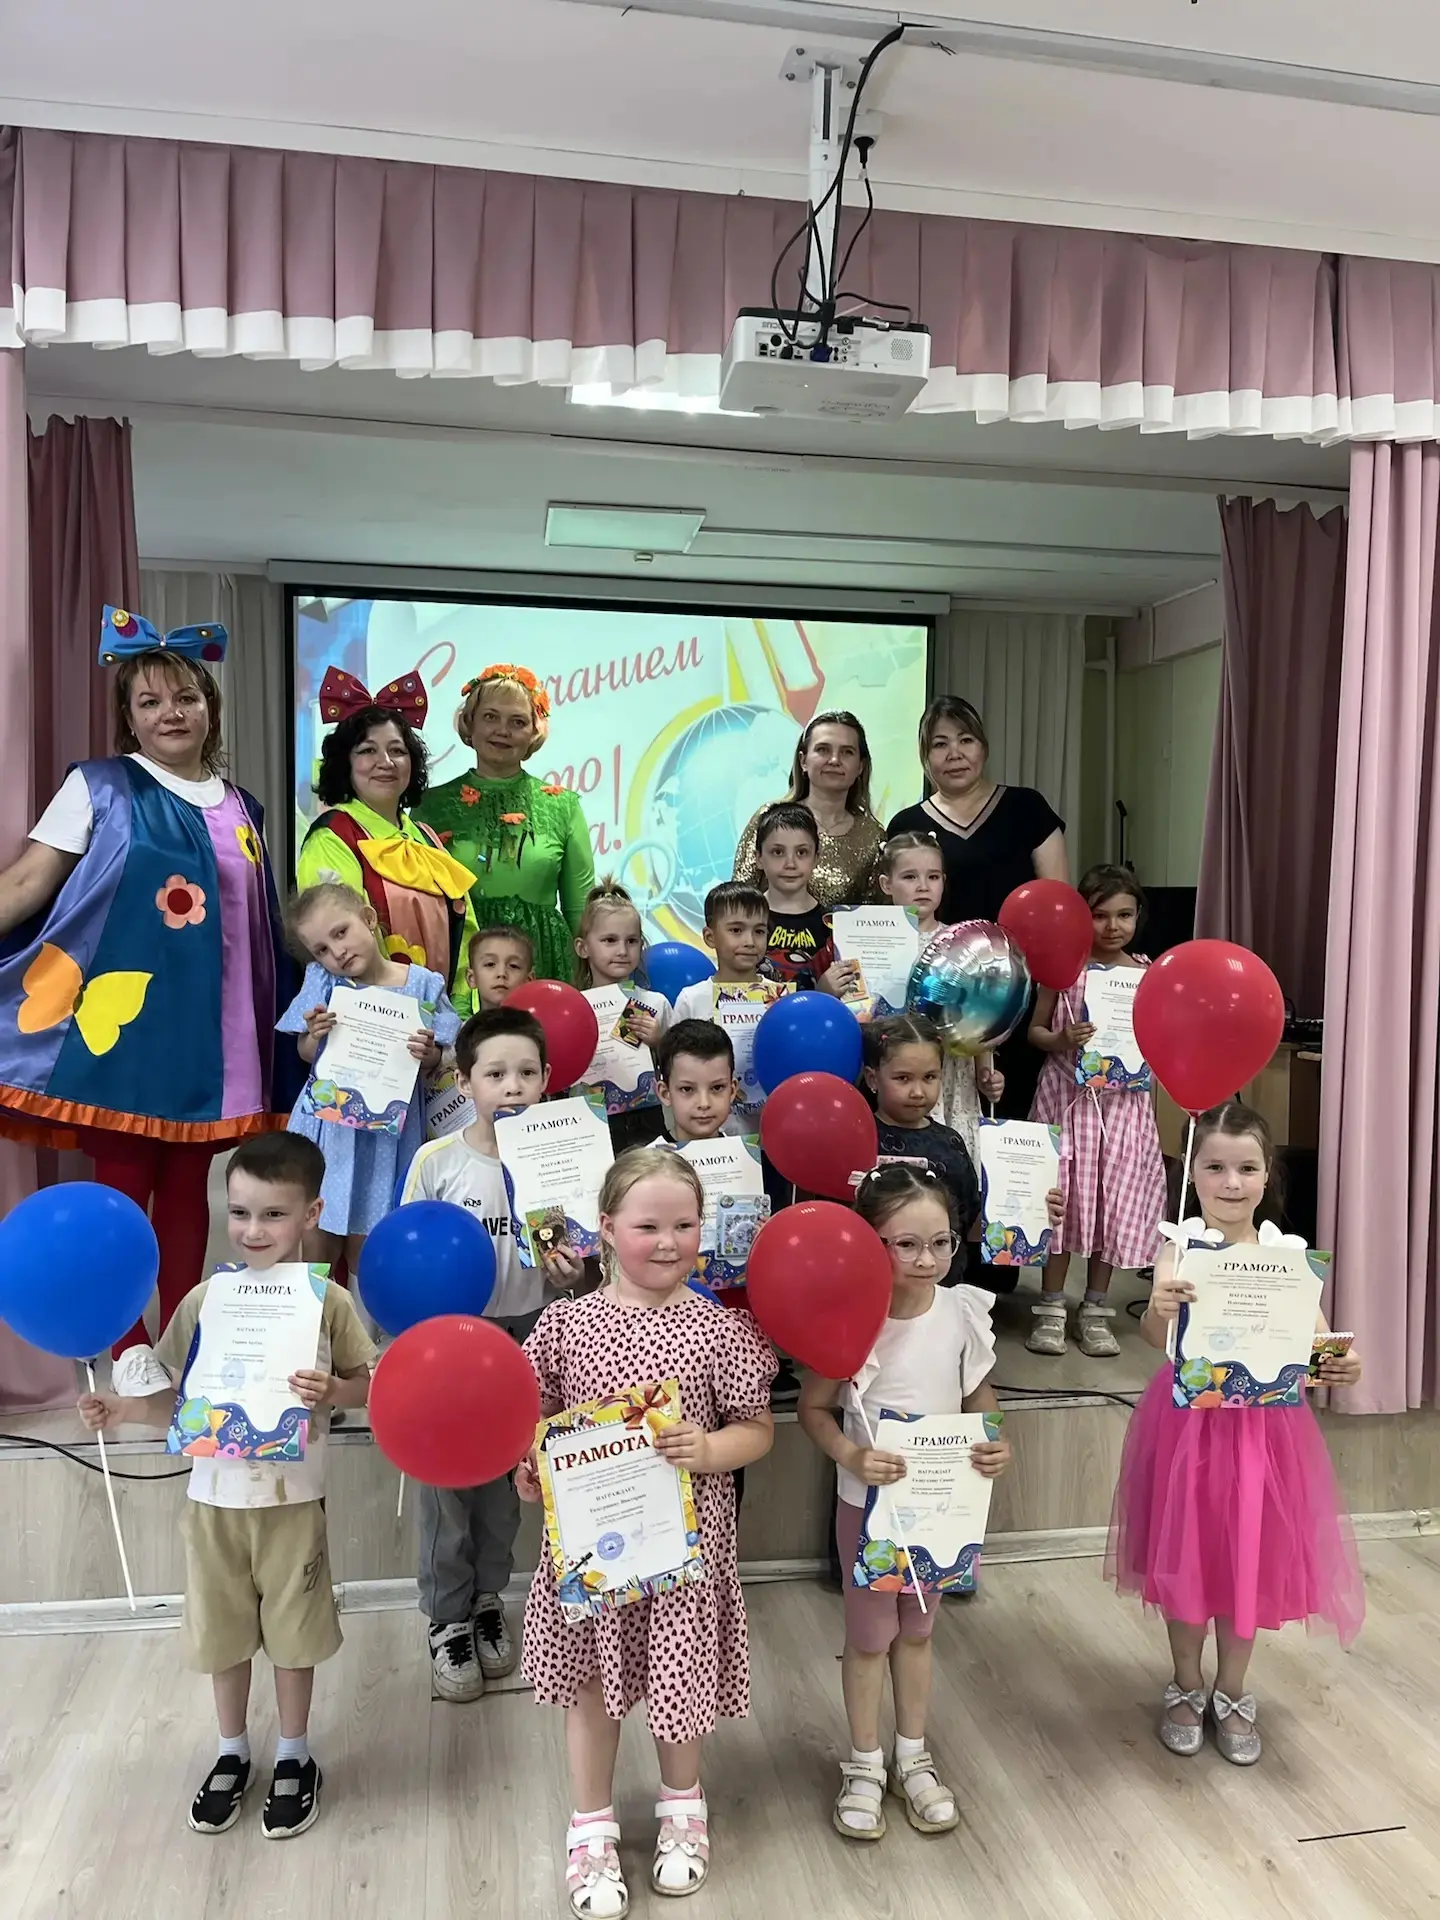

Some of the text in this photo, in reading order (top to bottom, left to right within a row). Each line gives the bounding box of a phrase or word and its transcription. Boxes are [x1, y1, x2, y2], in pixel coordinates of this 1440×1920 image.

[541, 636, 704, 706] чанием
[855, 919, 897, 928] ГРАМОТА
[767, 925, 817, 949] BATMAN
[1109, 980, 1140, 990] ГРАМО
[358, 1000, 405, 1020] ГРАМОТА
[722, 1014, 763, 1025] ГРАМО
[429, 1093, 467, 1127] ГРАМО
[526, 1116, 579, 1134] ГРАМОТА
[1003, 1136, 1042, 1148] ГРАМОТА
[1223, 1262, 1289, 1274] ГРАМОТА
[237, 1284, 292, 1296] ГРАМОТА
[912, 1435, 969, 1447] ГРАМОТА
[553, 1433, 651, 1473] ГРАМОТА
